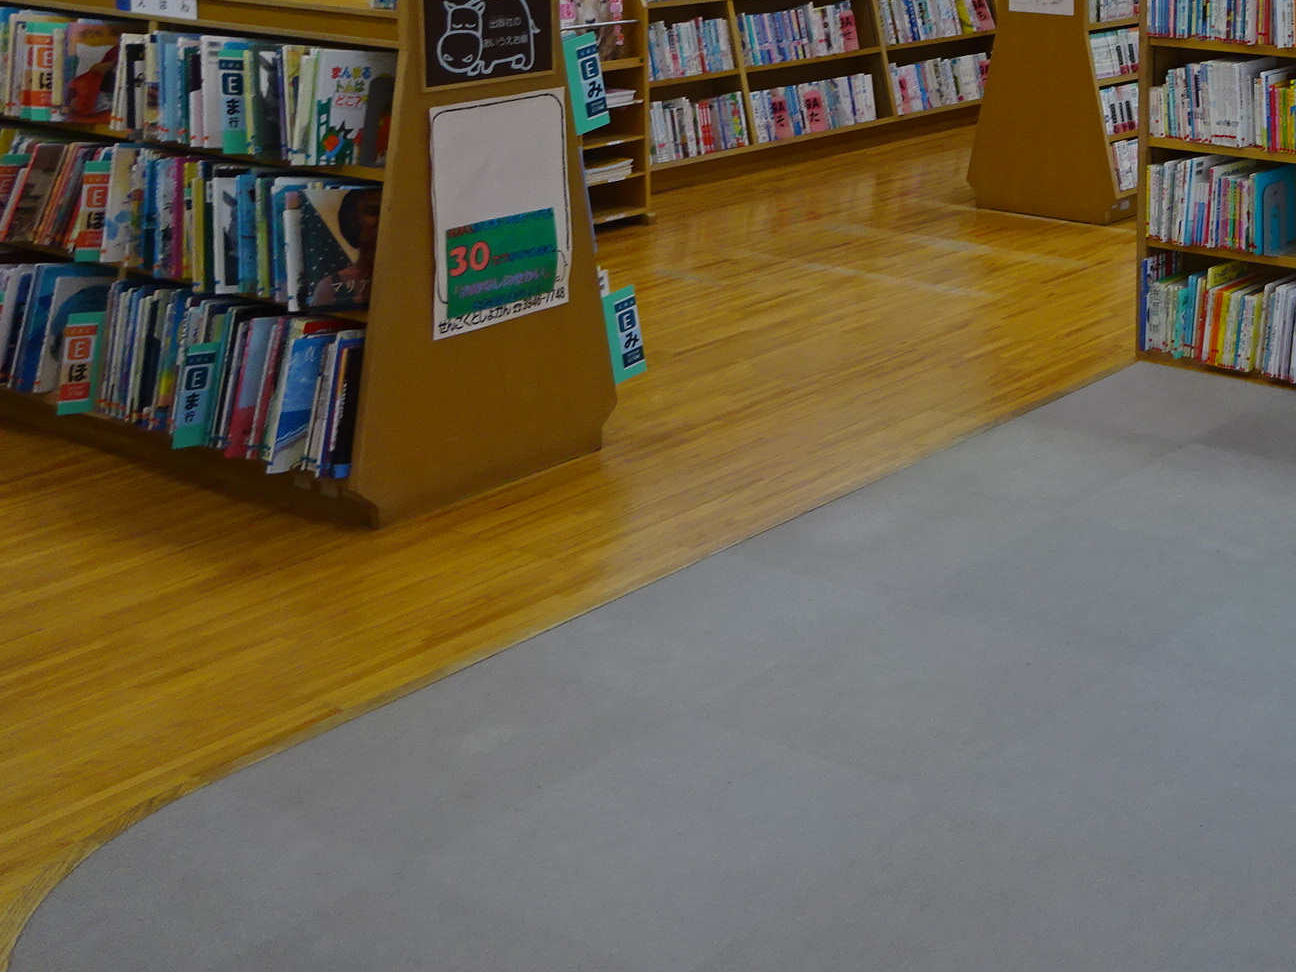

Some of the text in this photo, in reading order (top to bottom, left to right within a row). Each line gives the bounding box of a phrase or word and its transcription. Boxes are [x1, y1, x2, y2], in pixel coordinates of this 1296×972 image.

[585, 60, 596, 77] E
[228, 76, 238, 92] E
[587, 81, 603, 98] み
[623, 312, 633, 329] E
[624, 331, 640, 349] み
[74, 342, 85, 358] E
[68, 363, 88, 382] ほ
